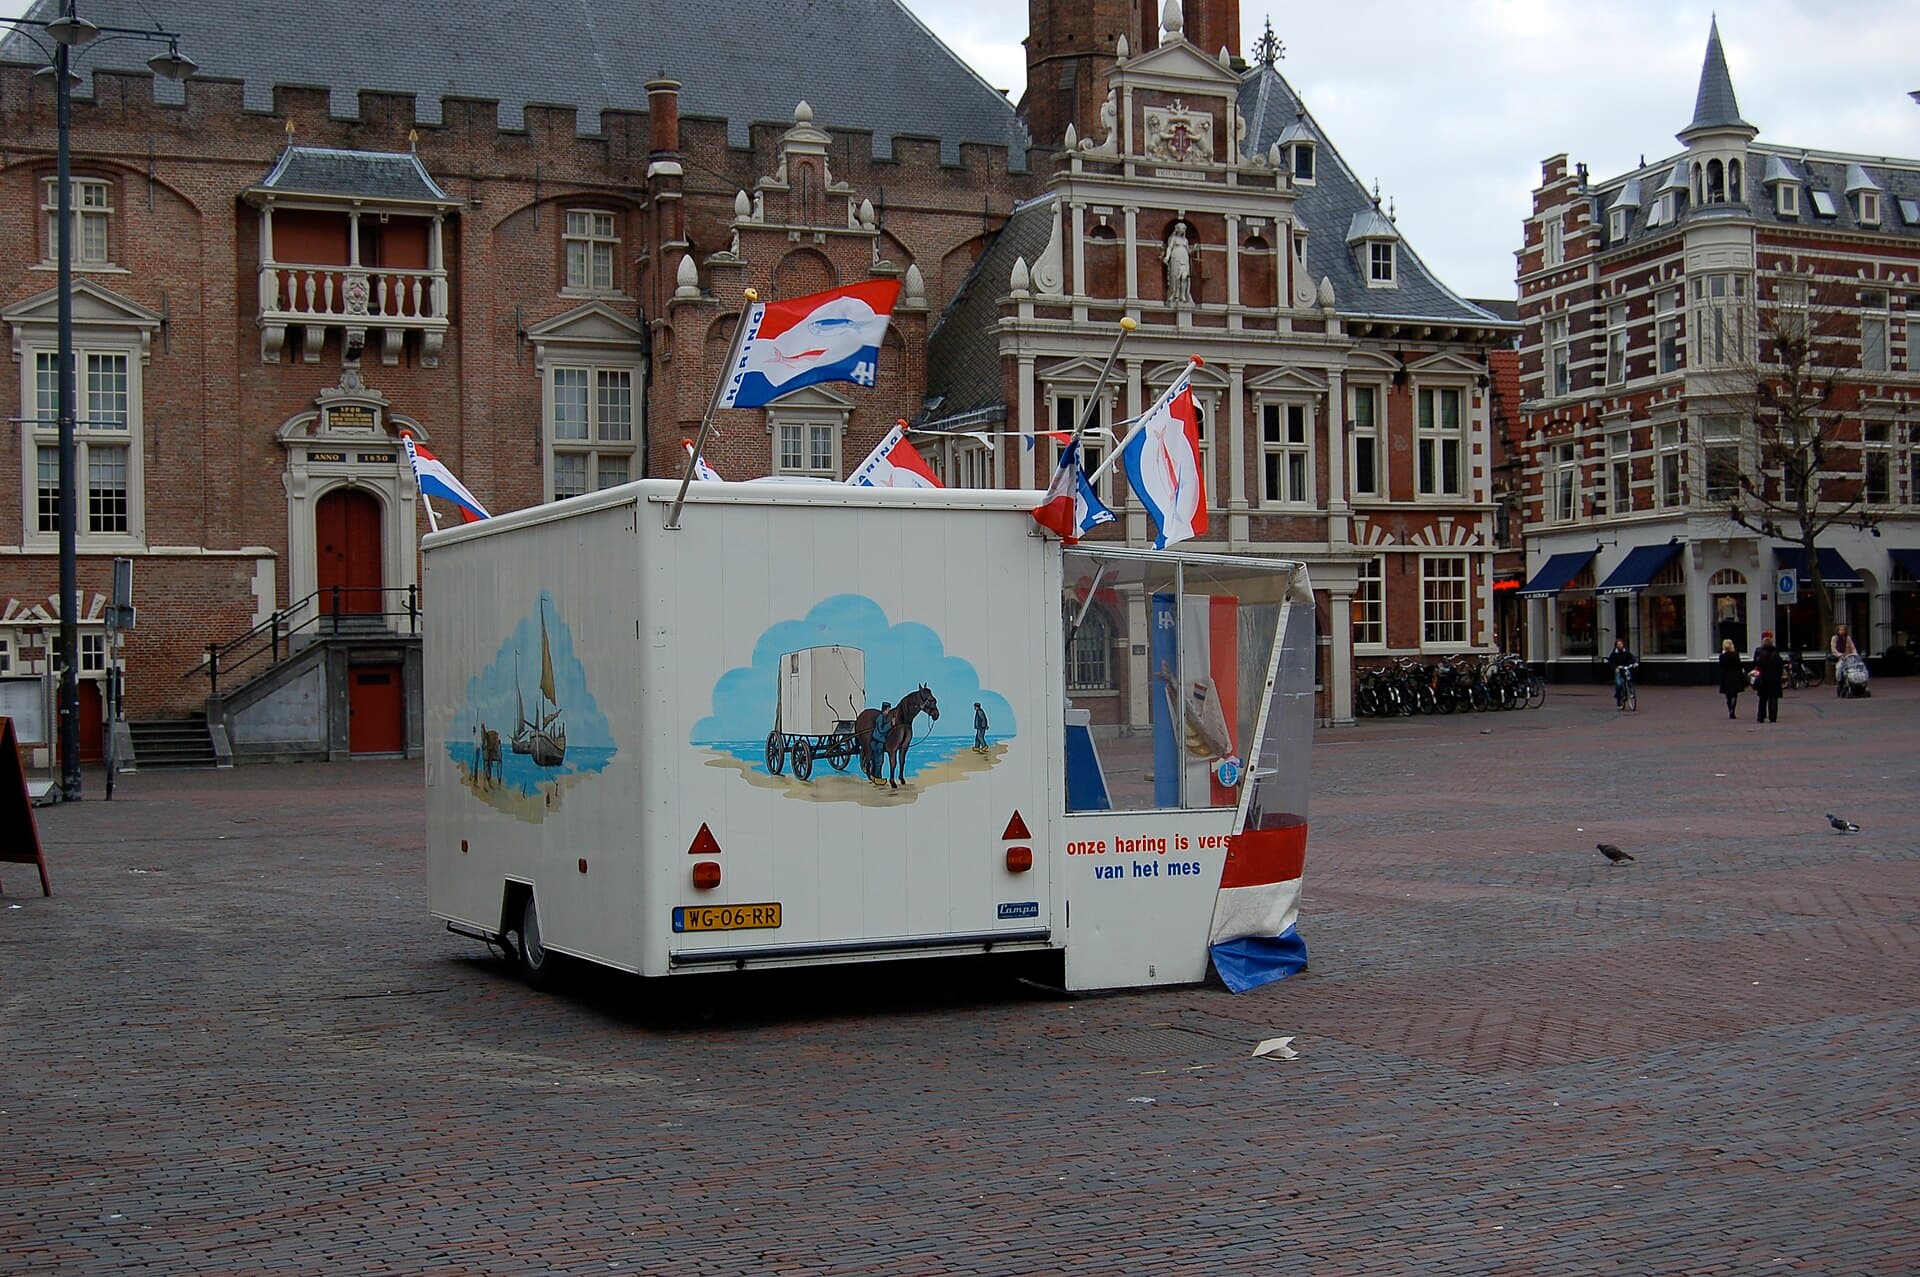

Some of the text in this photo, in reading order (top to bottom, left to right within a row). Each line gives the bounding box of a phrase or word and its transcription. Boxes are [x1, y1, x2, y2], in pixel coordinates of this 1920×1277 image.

[726, 310, 763, 401] HARING
[851, 435, 899, 487] ARING
[1066, 833, 1232, 855] onze haring is vers
[1094, 860, 1201, 880] van het mes
[689, 906, 776, 928] WG-06-RR
